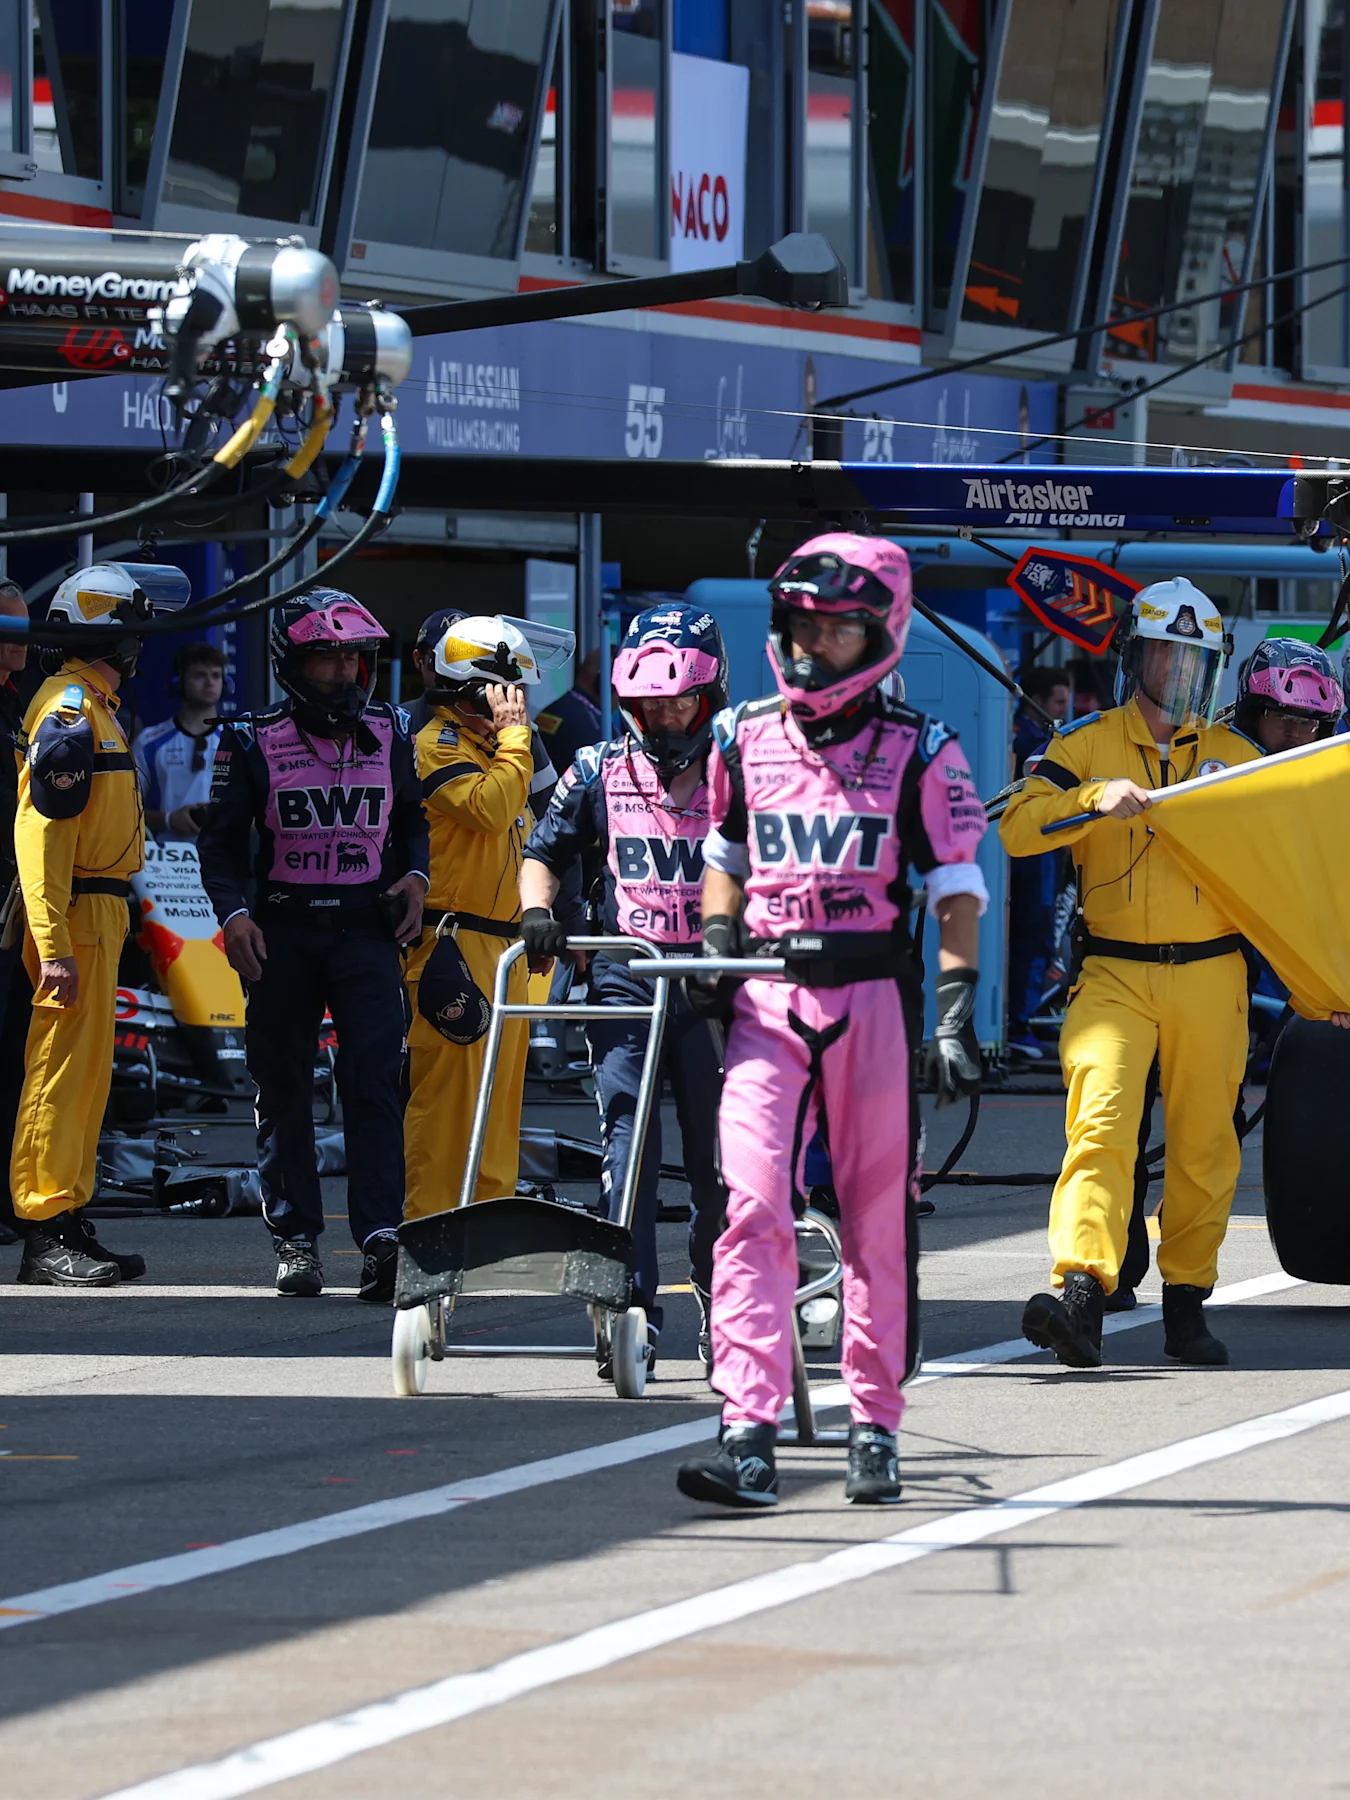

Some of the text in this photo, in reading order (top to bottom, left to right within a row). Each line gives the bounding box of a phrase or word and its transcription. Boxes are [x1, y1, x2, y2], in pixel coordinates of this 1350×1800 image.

[9, 303, 78, 319] HAAS
[84, 305, 109, 319] F1
[439, 361, 520, 410] ATLASSIAN
[625, 384, 666, 458] 55
[962, 478, 1093, 510] Airtasker
[697, 613, 713, 631] MSC
[1140, 607, 1167, 617] STANDS
[288, 759, 315, 770] MSC
[275, 785, 387, 830] BWT
[625, 803, 655, 813] MSC
[302, 831, 329, 840] WATER
[332, 830, 381, 839] TECHNOLOGY
[751, 811, 893, 871] BWT
[285, 844, 330, 870] eni
[614, 836, 704, 884] BW
[157, 881, 203, 890] dynatrac
[164, 907, 210, 918] Mobil
[767, 888, 814, 919] eni
[629, 904, 678, 932] eni
